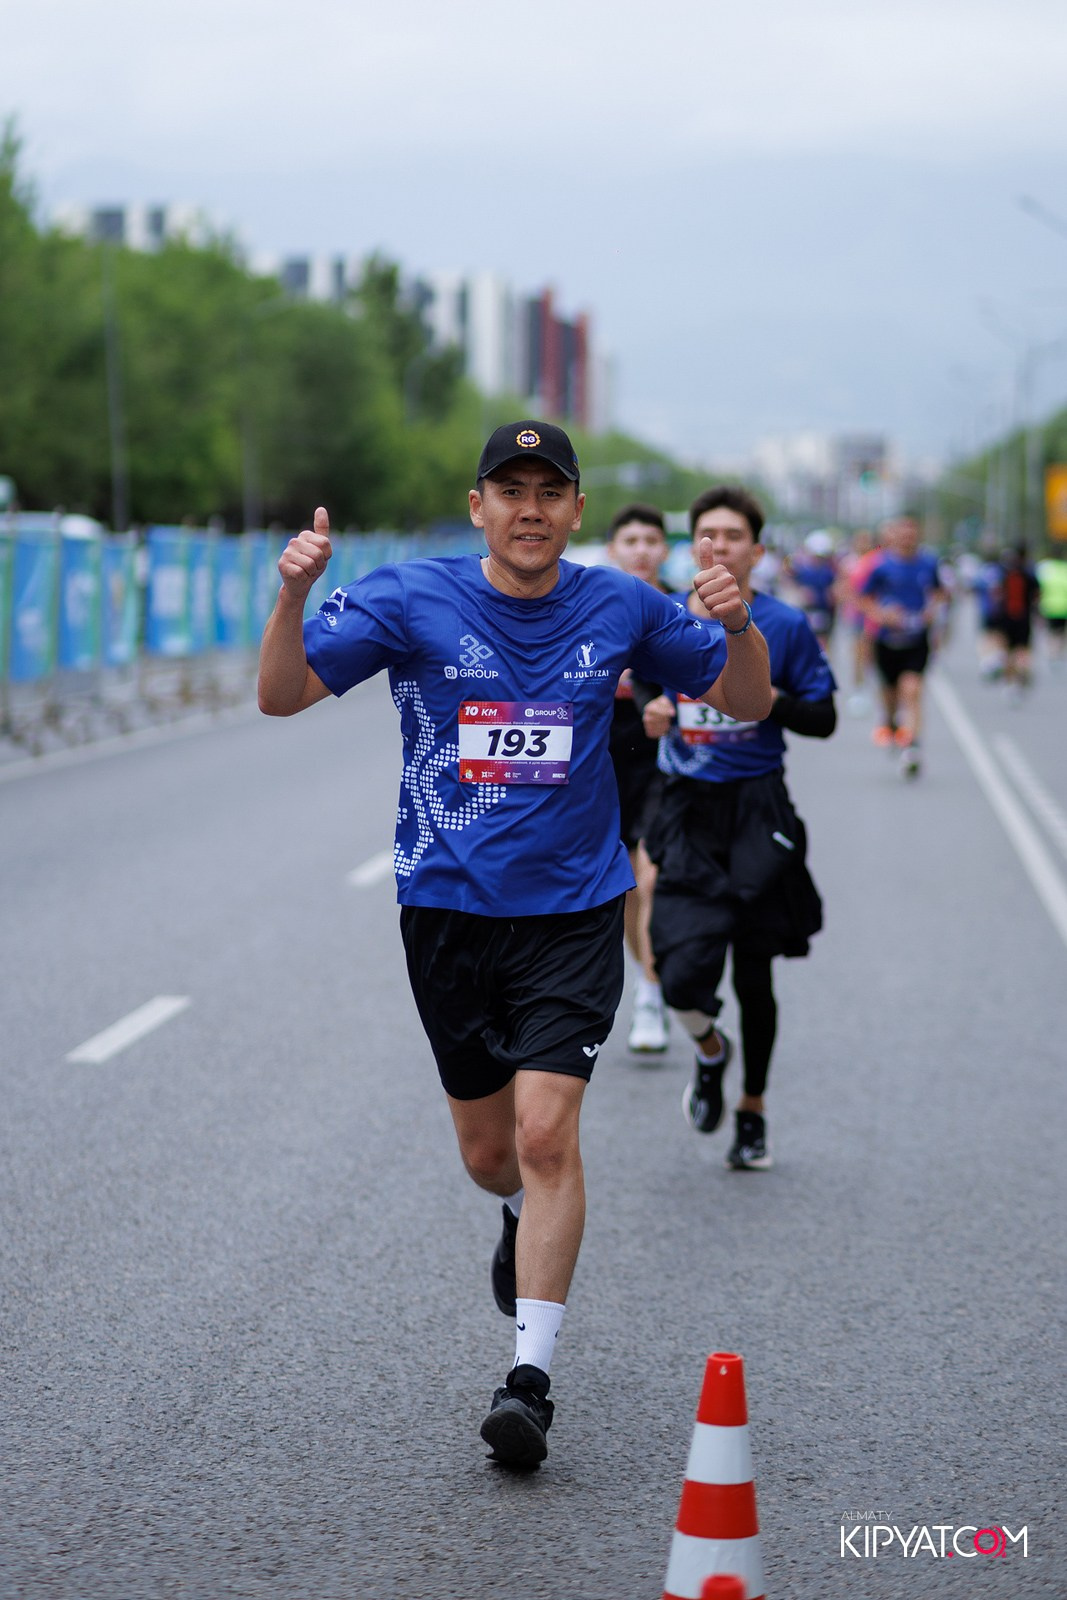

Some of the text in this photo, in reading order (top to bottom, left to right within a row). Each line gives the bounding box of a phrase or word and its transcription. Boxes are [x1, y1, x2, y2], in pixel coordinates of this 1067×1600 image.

[521, 435, 536, 443] RG
[445, 666, 499, 679] BI GROUP
[563, 671, 573, 679] BI
[464, 706, 498, 717] 10 KM
[487, 728, 551, 758] 193
